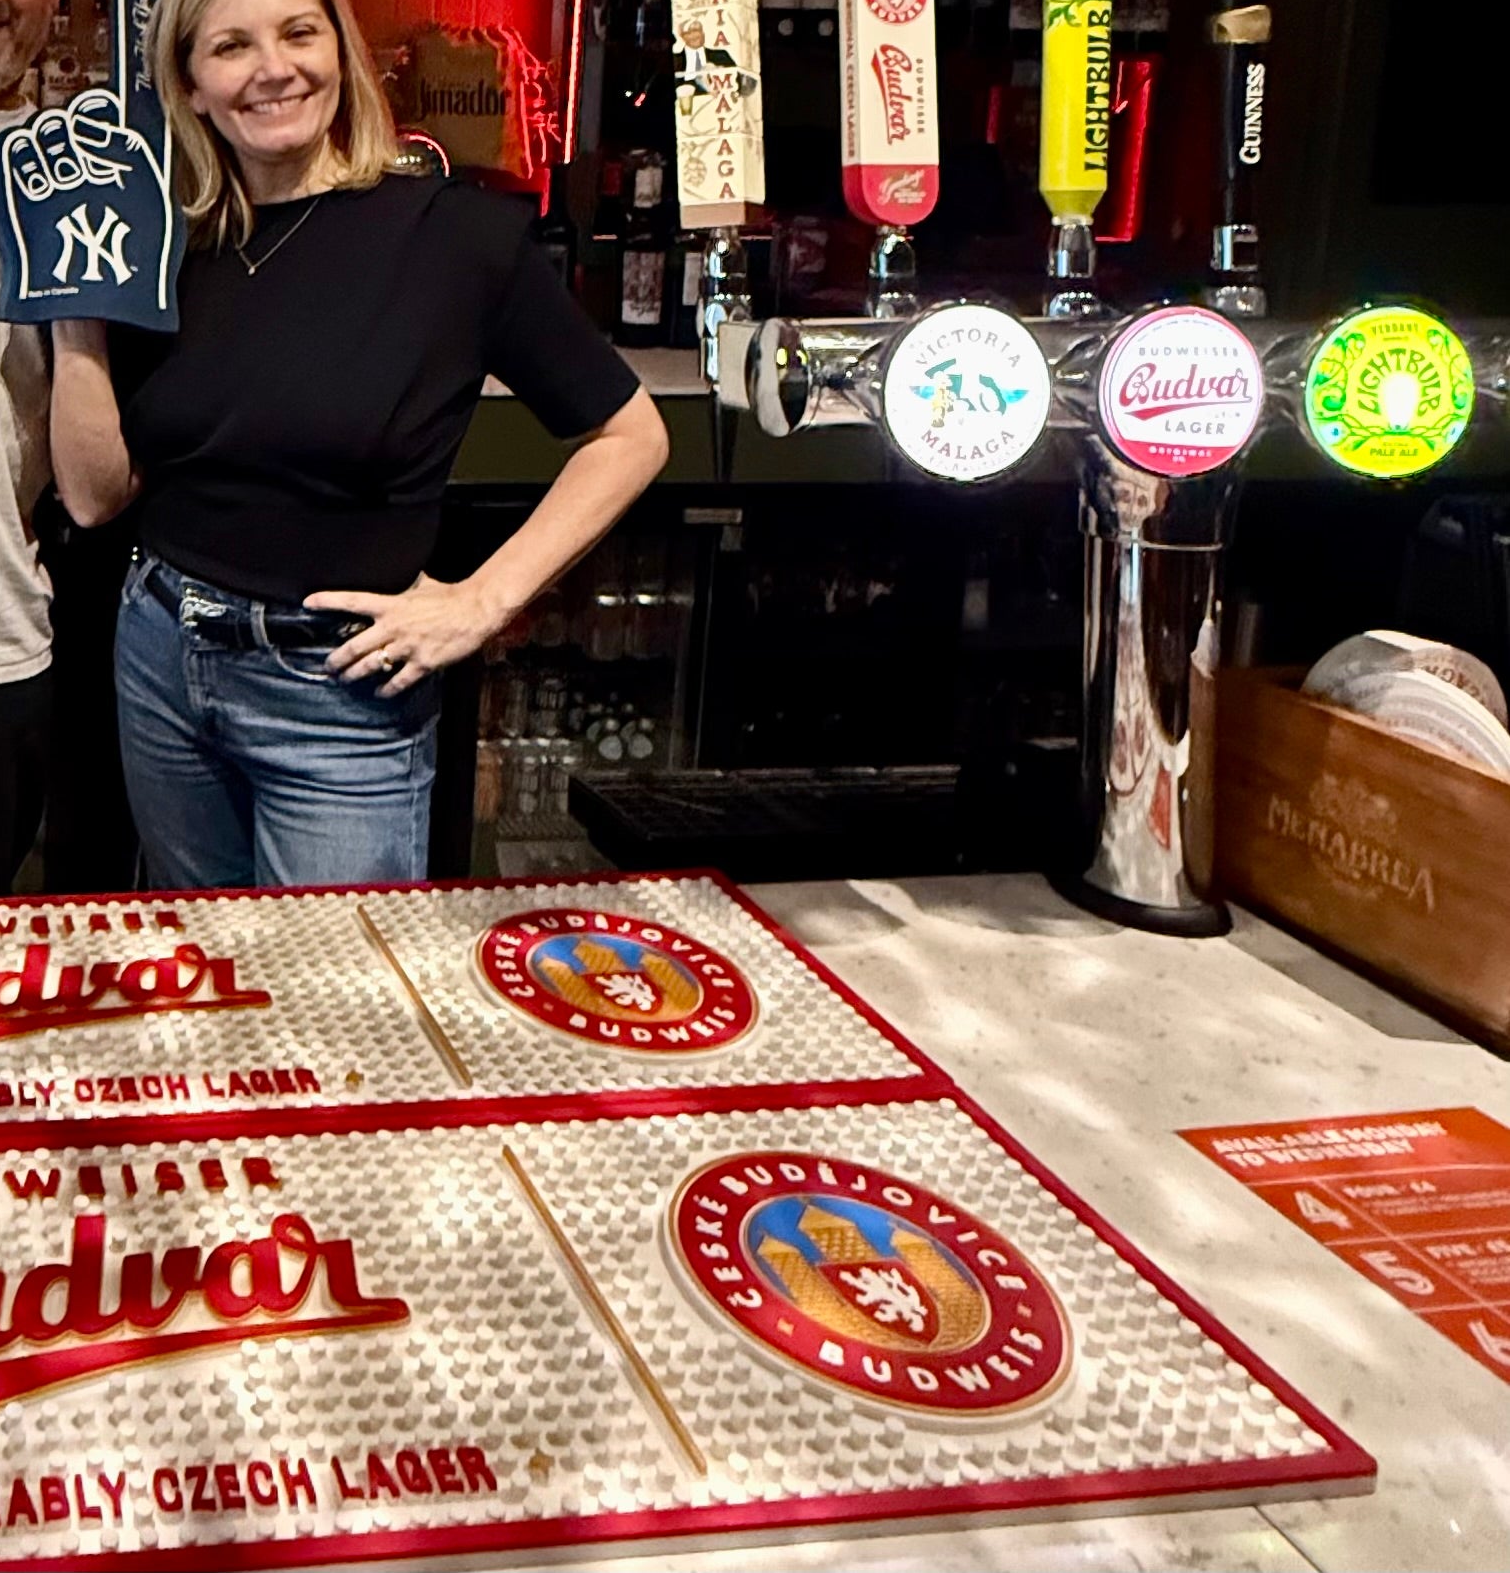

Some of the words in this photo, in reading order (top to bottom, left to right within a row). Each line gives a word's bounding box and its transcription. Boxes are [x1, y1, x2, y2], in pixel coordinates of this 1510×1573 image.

[872, 44, 913, 145] Budvar
[1084, 9, 1111, 172] LIGHTBULB
[1239, 62, 1266, 165] GUINNESS
[712, 73, 735, 199] MALAGA
[915, 328, 1022, 368] VICTORIA
[1138, 346, 1240, 358] BUDWEISER
[1119, 362, 1253, 418] Budvar
[1357, 347, 1441, 417] LIGHTBULB
[921, 428, 1016, 460] MALAGA
[1164, 420, 1226, 435] LAGER
[1369, 447, 1396, 457] PALE
[1399, 447, 1419, 457] ALE
[73, 1072, 190, 1105] CZECH
[201, 1067, 322, 1099] LAGER
[1225, 1152, 1266, 1169] TO
[1294, 1189, 1353, 1230] 4
[1358, 1249, 1436, 1296] 5
[818, 1326, 1045, 1393] BUDWEIS
[151, 1455, 319, 1514] CZECH
[331, 1445, 499, 1501] LAGER
